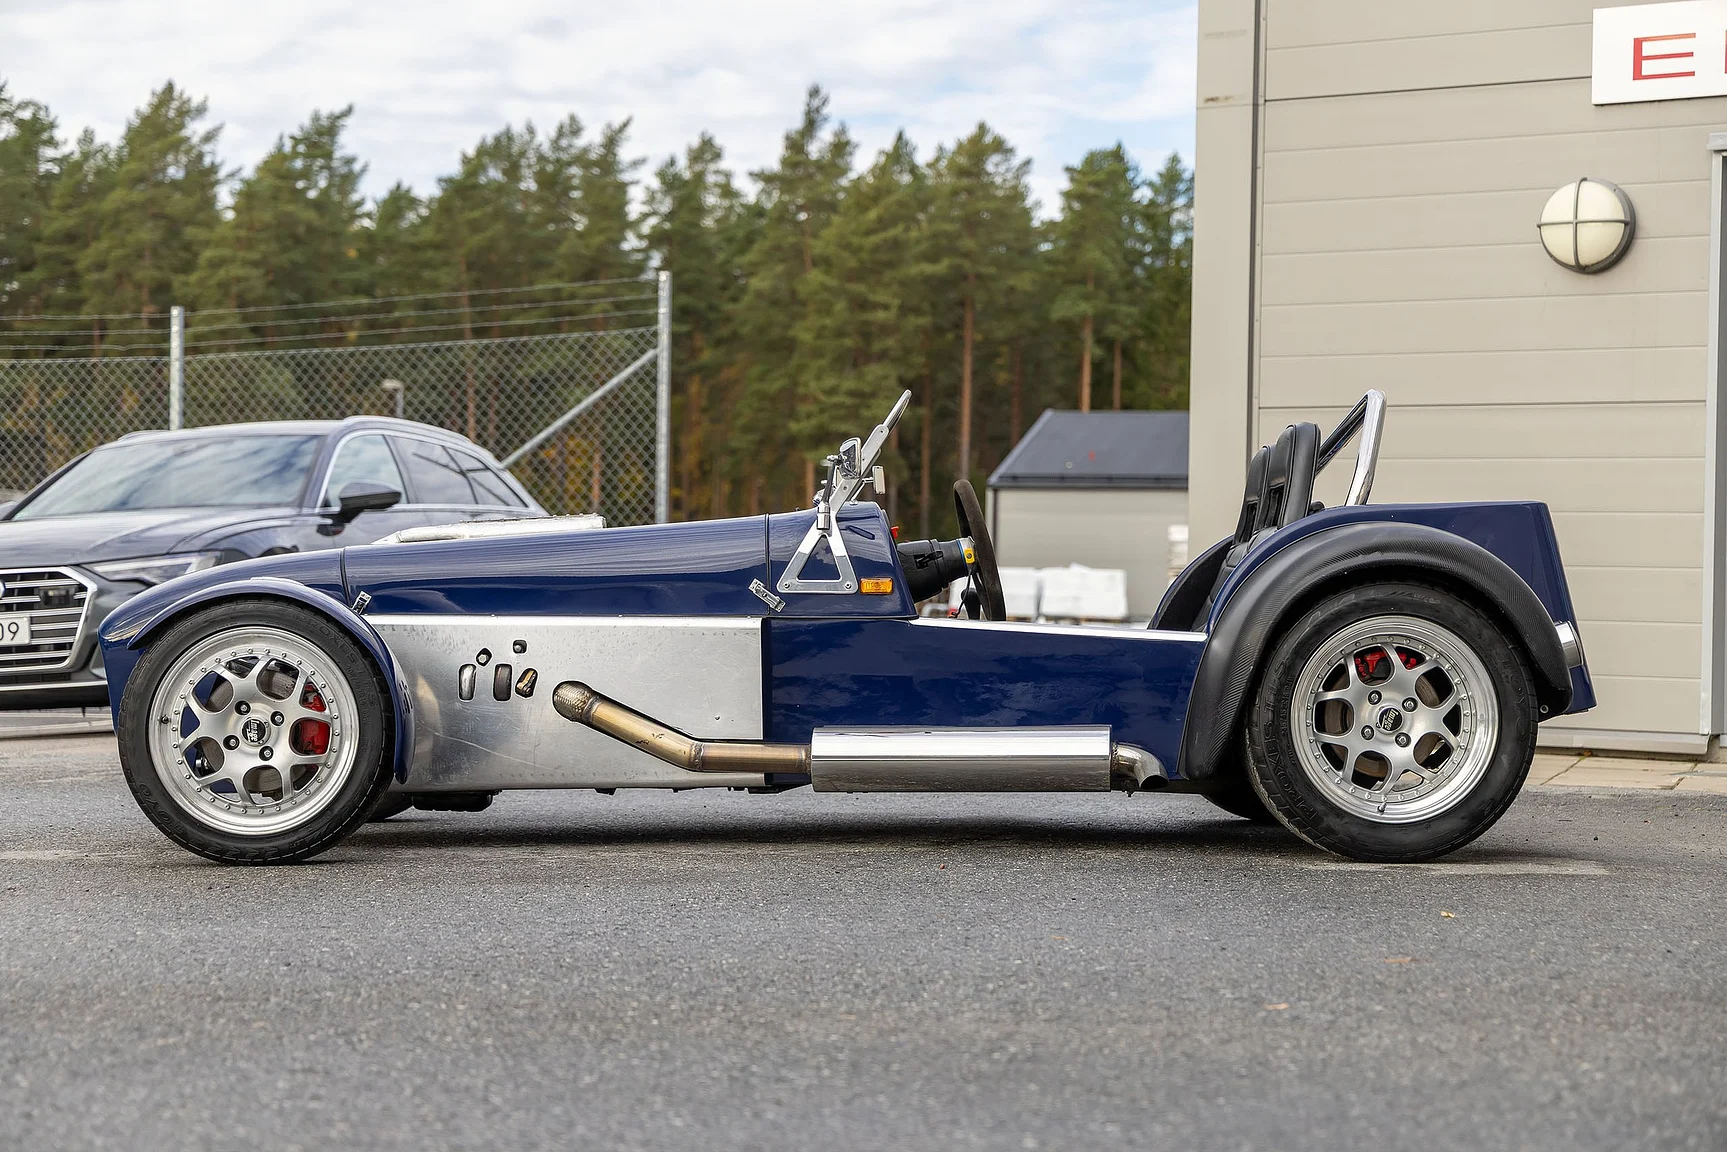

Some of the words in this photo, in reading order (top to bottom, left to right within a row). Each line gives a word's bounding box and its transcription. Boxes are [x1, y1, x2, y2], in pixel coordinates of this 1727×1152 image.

[1632, 27, 1727, 81] E
[1264, 722, 1318, 820] PROXES
[139, 783, 185, 834] TOYO
